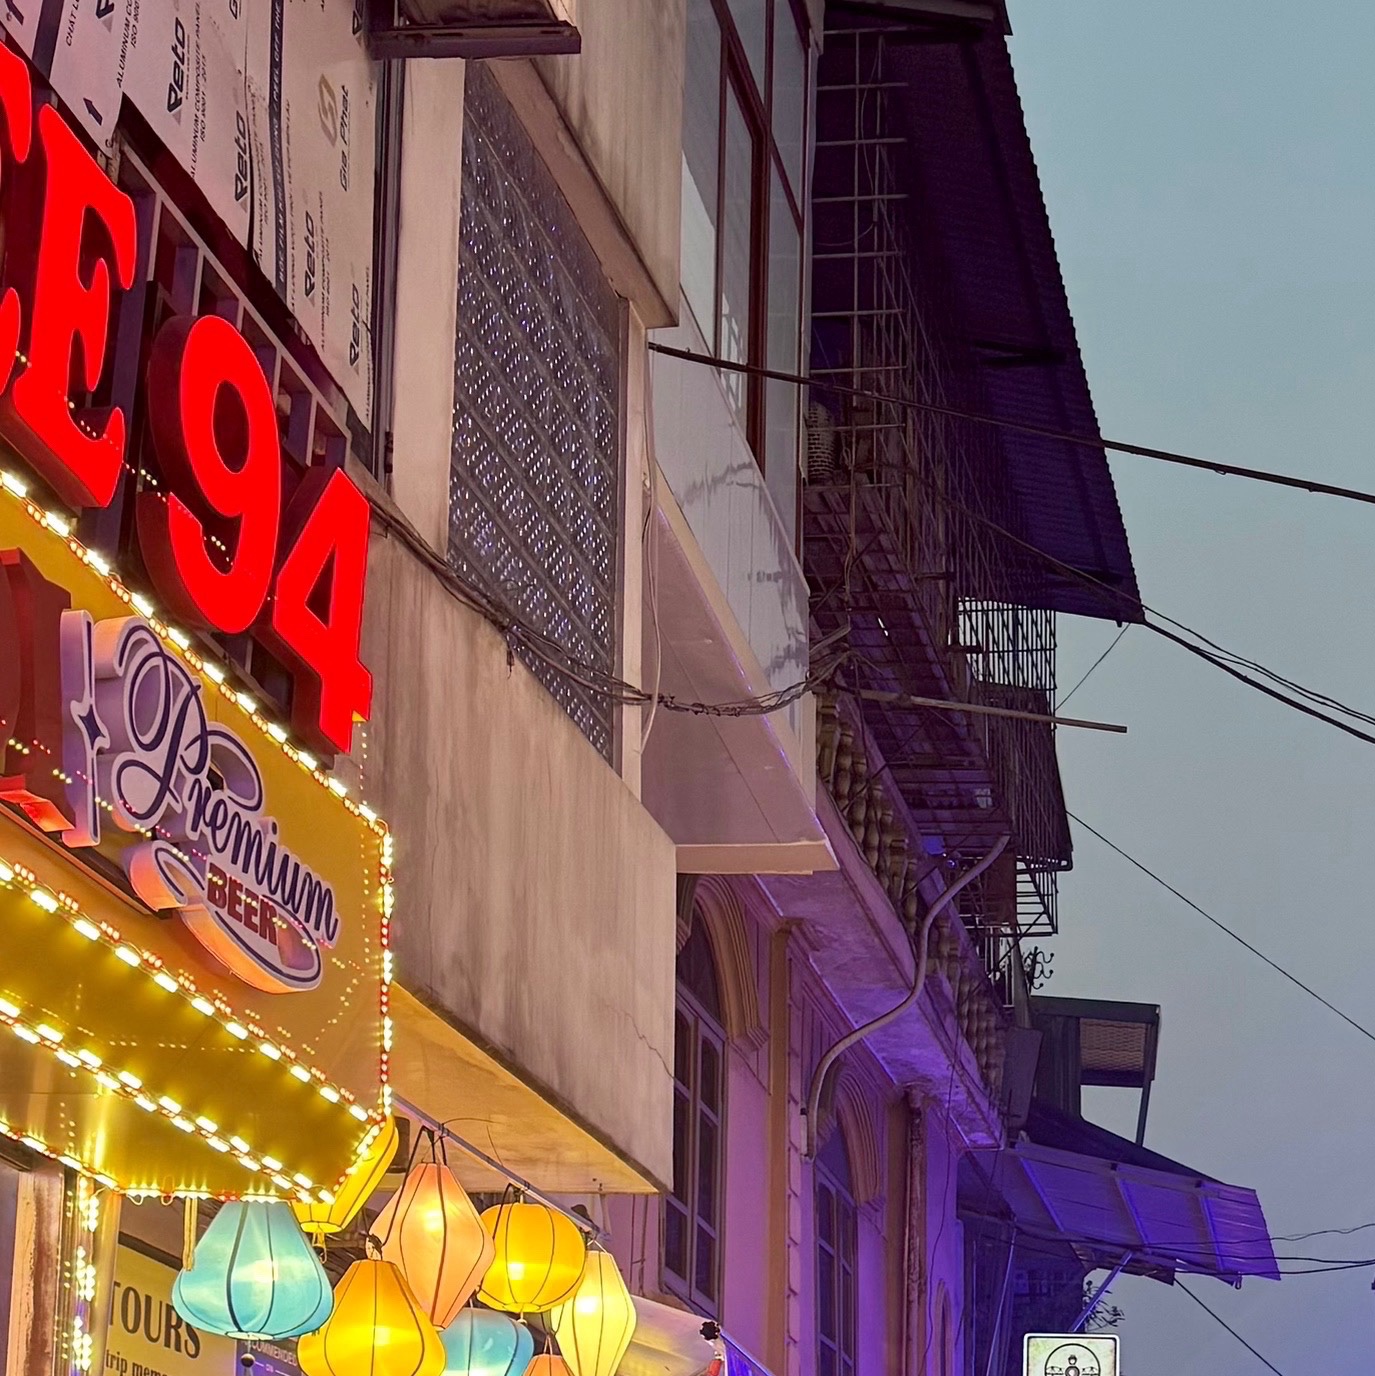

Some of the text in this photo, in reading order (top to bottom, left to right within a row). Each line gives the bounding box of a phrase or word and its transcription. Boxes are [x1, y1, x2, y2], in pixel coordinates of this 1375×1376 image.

[116, 17, 131, 89] ALUMINUM
[167, 16, 185, 113] Reto
[235, 110, 248, 201] Reto
[304, 210, 316, 297] Reto
[168, 315, 372, 752] 94
[116, 624, 339, 941] Premium
[206, 862, 280, 945] BEER
[105, 1349, 128, 1376] trip
